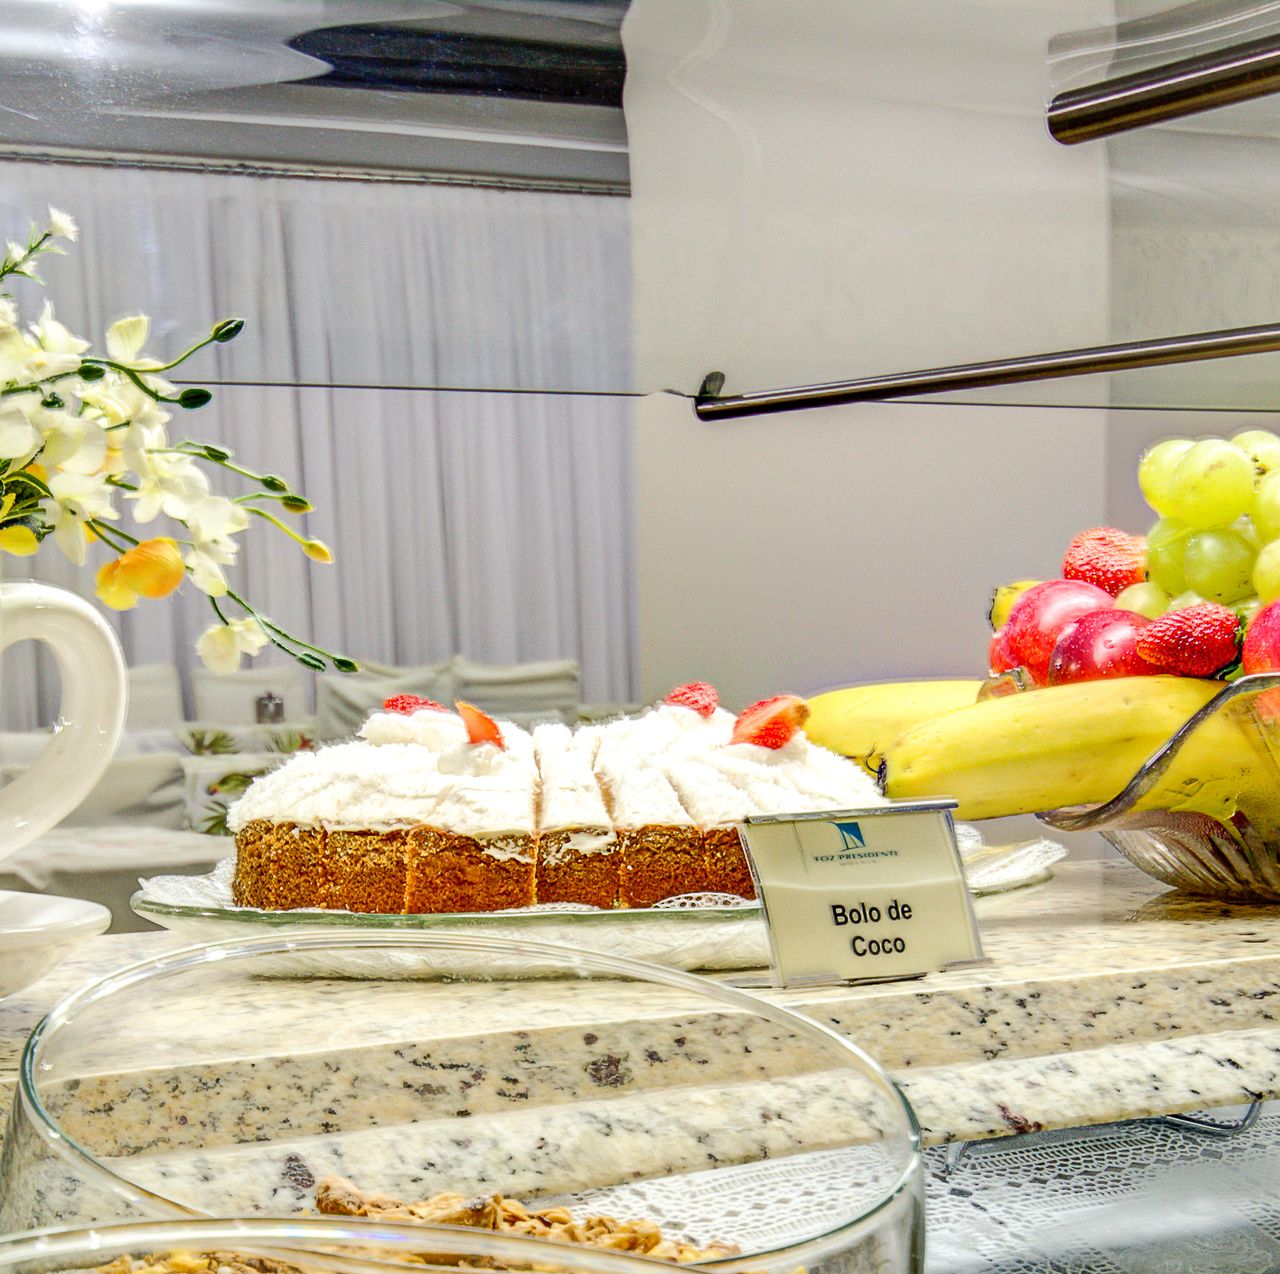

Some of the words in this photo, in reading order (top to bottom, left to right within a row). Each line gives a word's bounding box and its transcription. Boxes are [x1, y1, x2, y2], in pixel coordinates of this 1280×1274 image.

[831, 902, 881, 926] Bolo
[888, 899, 913, 920] de
[851, 935, 906, 957] Coco
